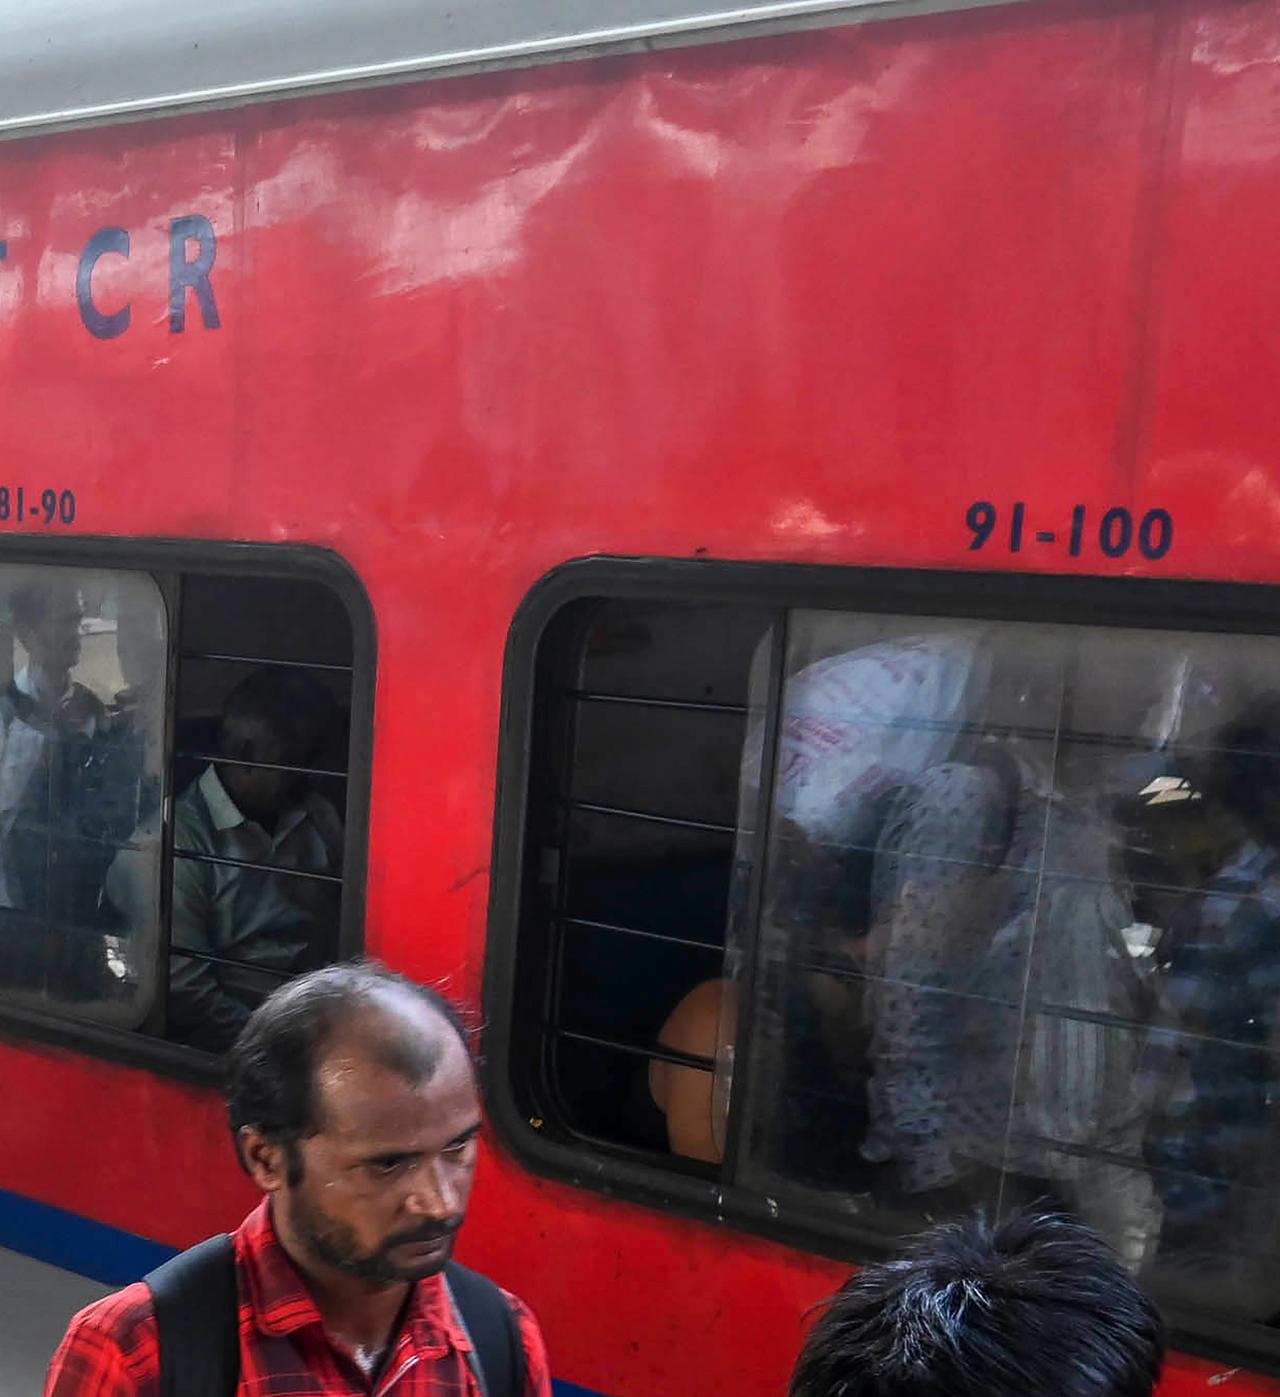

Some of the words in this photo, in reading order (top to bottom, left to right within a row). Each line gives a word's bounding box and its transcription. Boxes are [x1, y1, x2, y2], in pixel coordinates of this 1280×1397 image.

[75, 227, 130, 340] C
[170, 214, 221, 333] R
[966, 502, 1174, 560] 91-100
